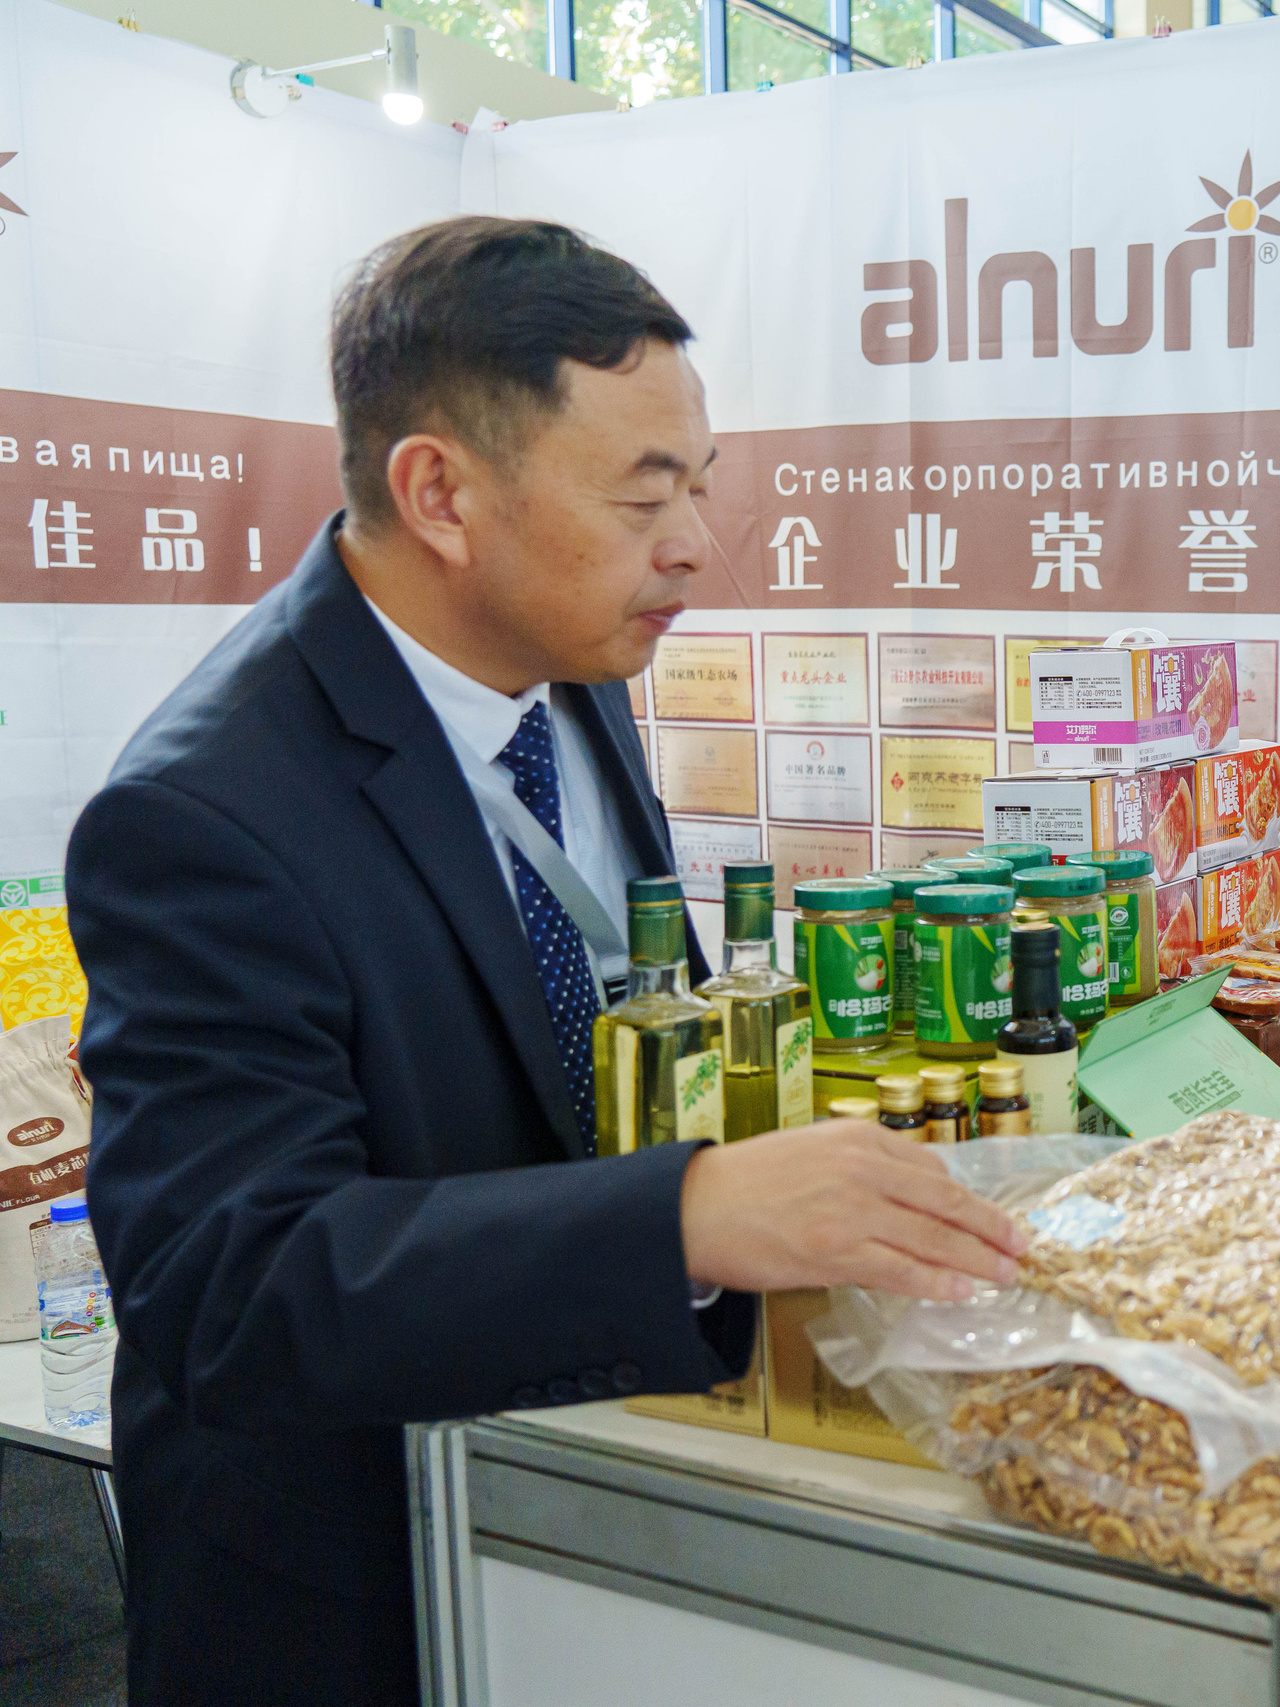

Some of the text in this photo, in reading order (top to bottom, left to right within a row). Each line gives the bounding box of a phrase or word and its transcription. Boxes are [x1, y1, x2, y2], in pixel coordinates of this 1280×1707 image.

[860, 196, 1257, 367] alnuri
[665, 668, 738, 682] 国家级生态农场
[781, 670, 847, 685] 重点龙头企业
[16, 1119, 56, 1141] alnuri
[15, 1194, 41, 1205] FLOUR
